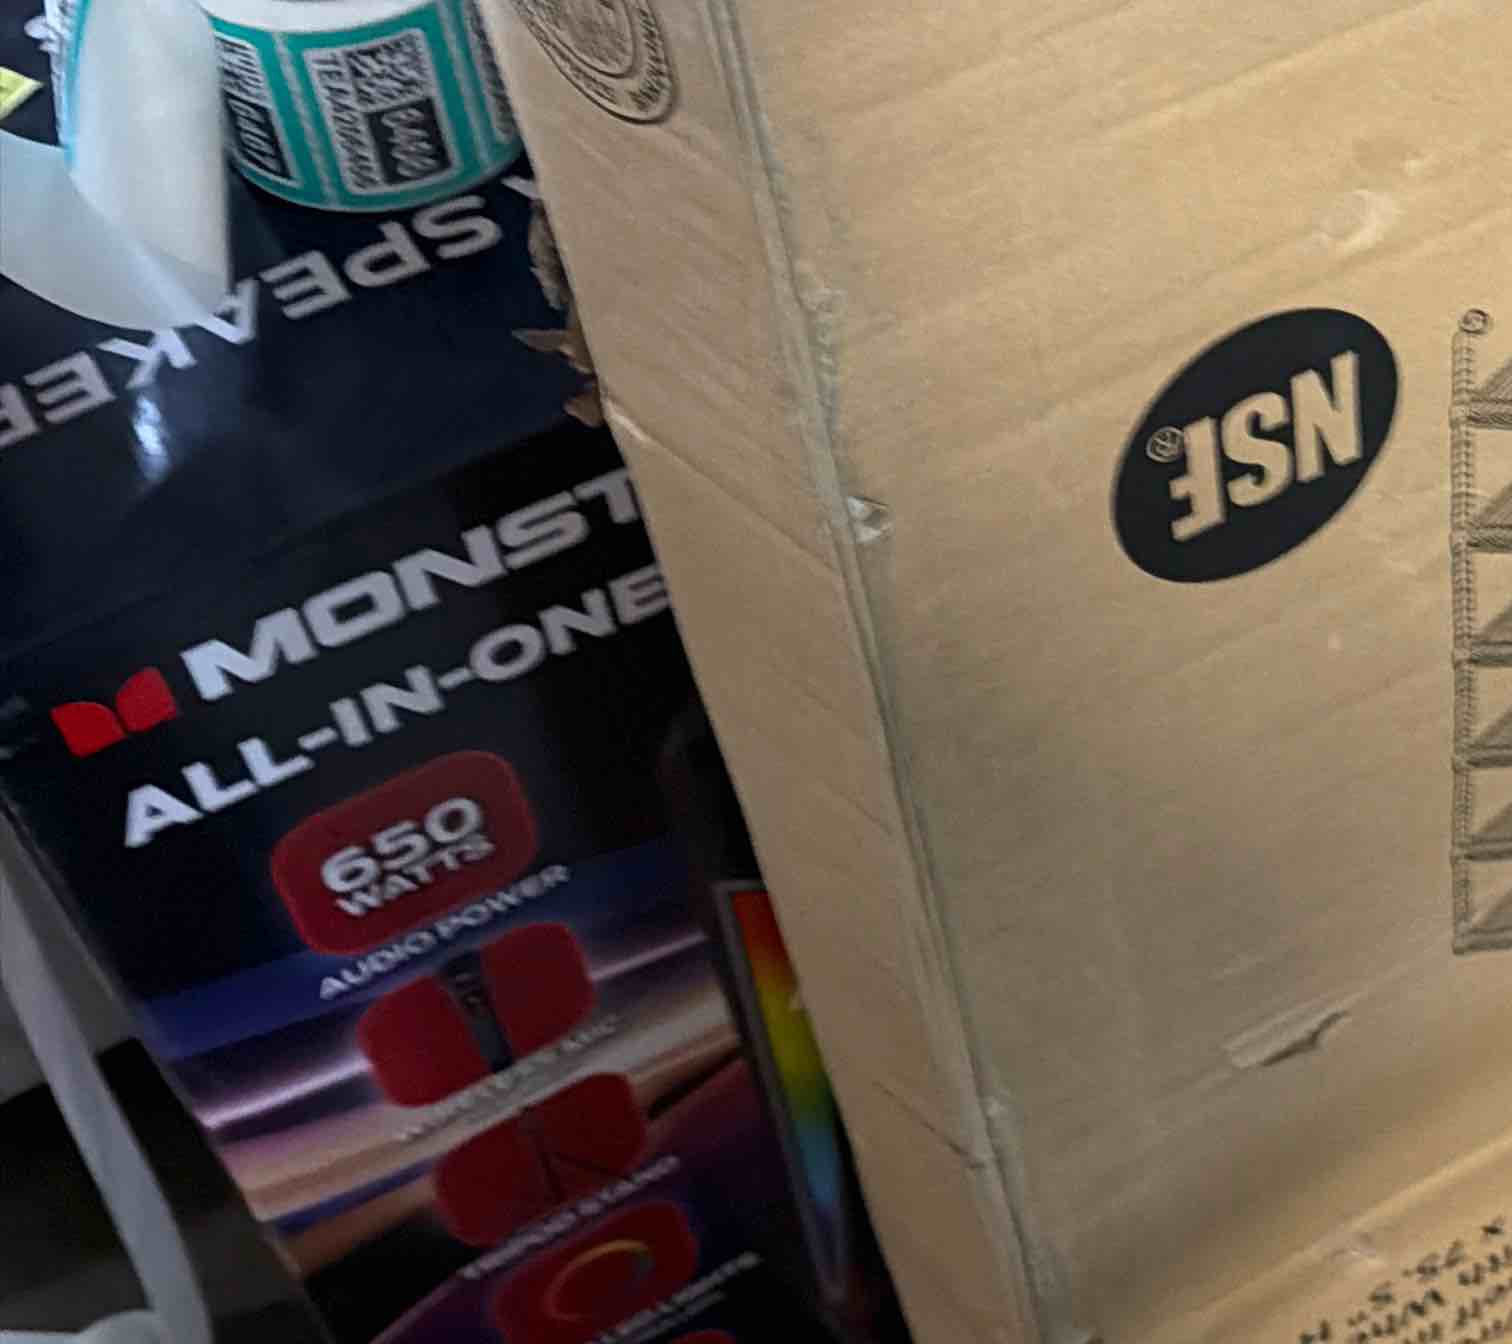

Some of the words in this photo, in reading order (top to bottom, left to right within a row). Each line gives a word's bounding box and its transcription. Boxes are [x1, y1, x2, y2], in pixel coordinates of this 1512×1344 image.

[1168, 349, 1364, 543] NSF
[124, 564, 668, 848] ALL-IN-ONE
[320, 797, 482, 895] 650
[336, 833, 496, 918] WATTS
[320, 931, 438, 1000] AUDIO
[435, 864, 572, 941] POWER
